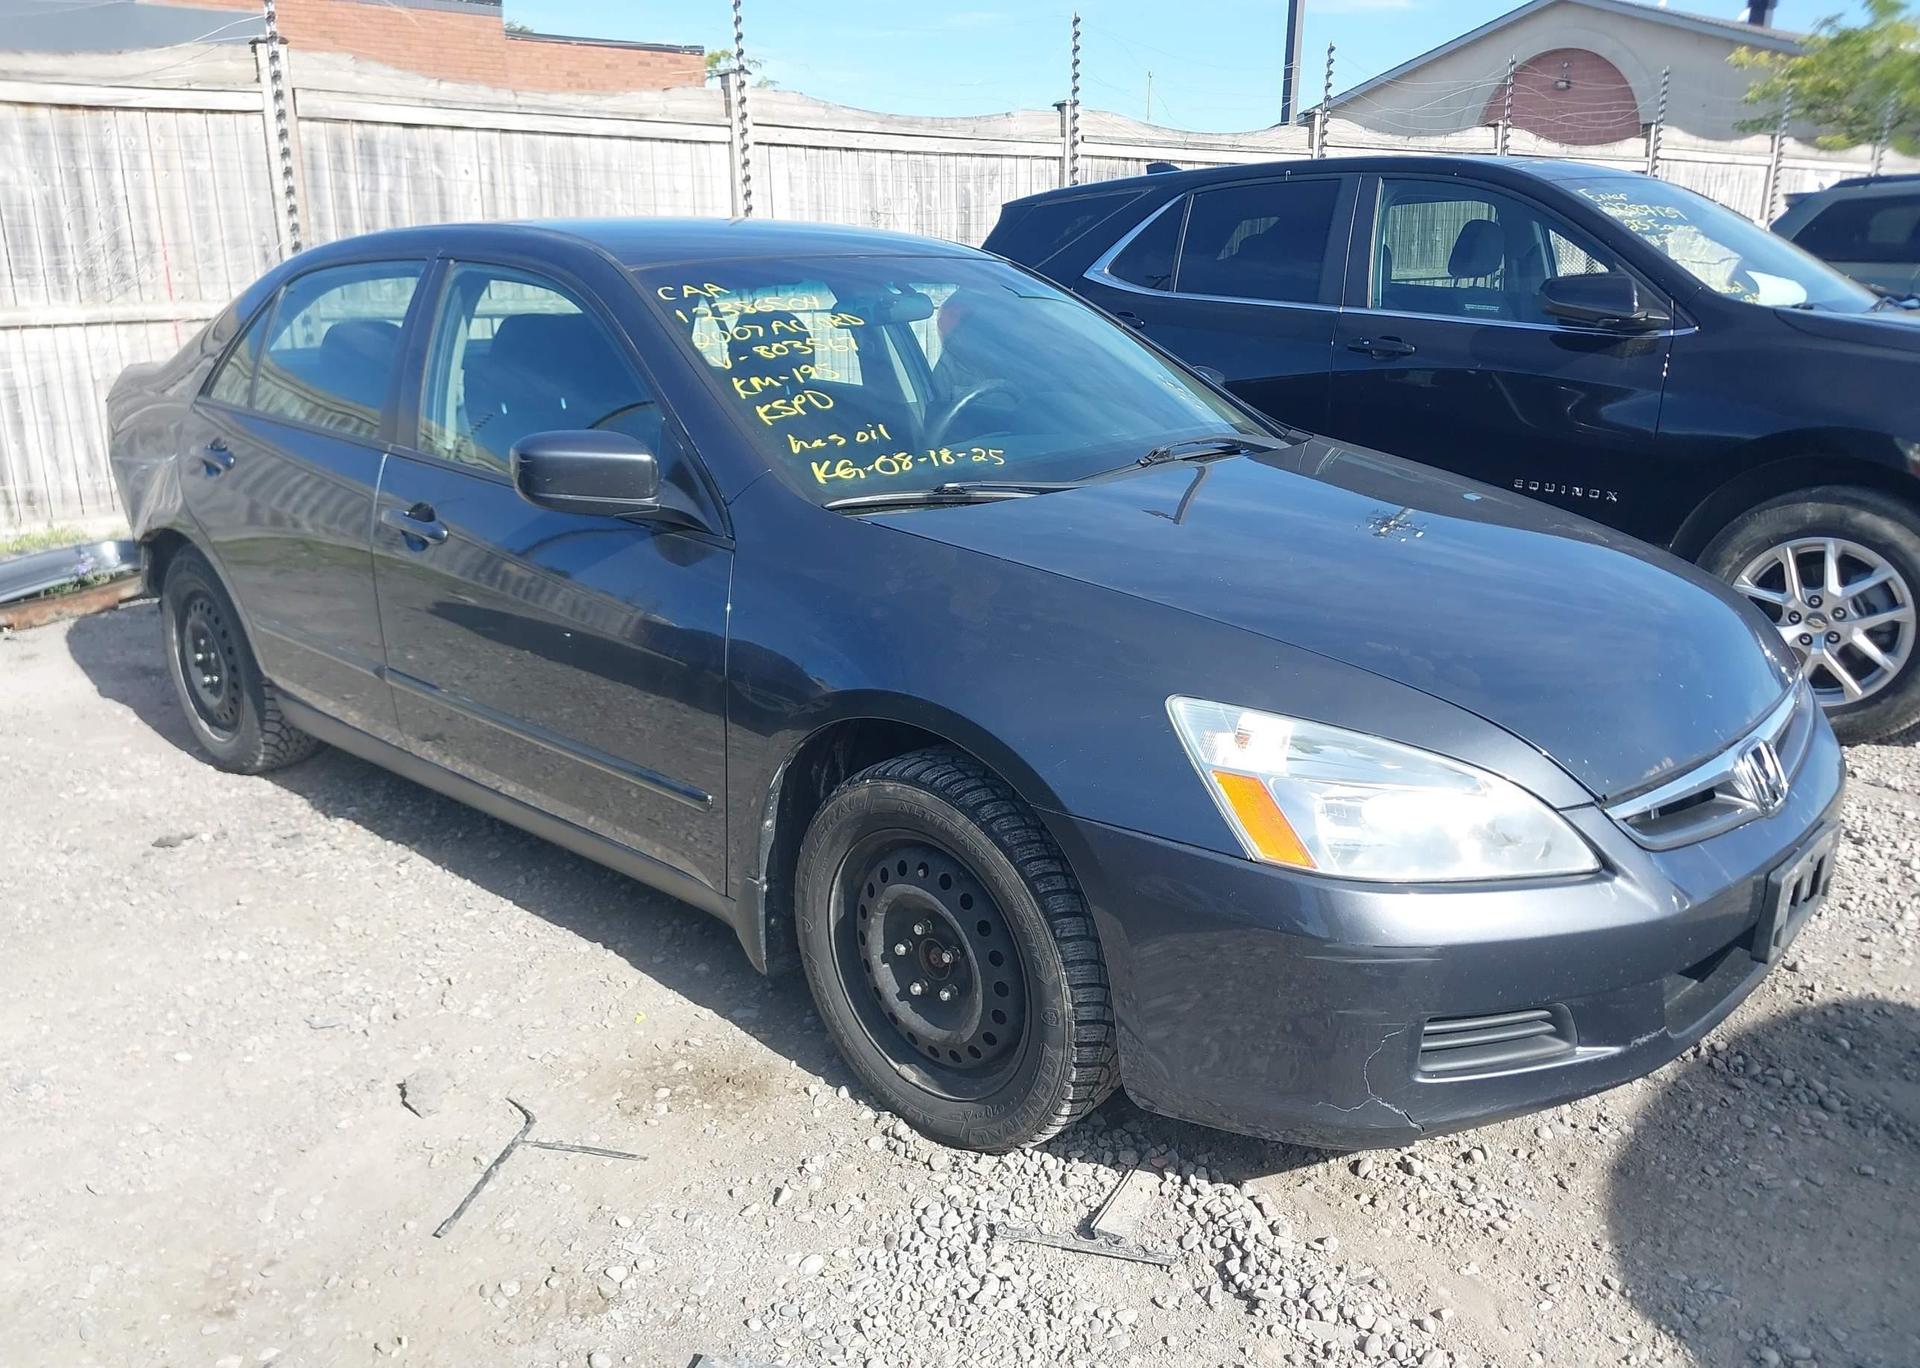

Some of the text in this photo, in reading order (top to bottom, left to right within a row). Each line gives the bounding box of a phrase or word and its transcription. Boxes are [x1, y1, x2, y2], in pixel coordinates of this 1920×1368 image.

[657, 283, 730, 300] CAA
[756, 389, 834, 425] KSPD
[787, 423, 892, 454] has oil
[1513, 479, 1618, 502] EQUINOX
